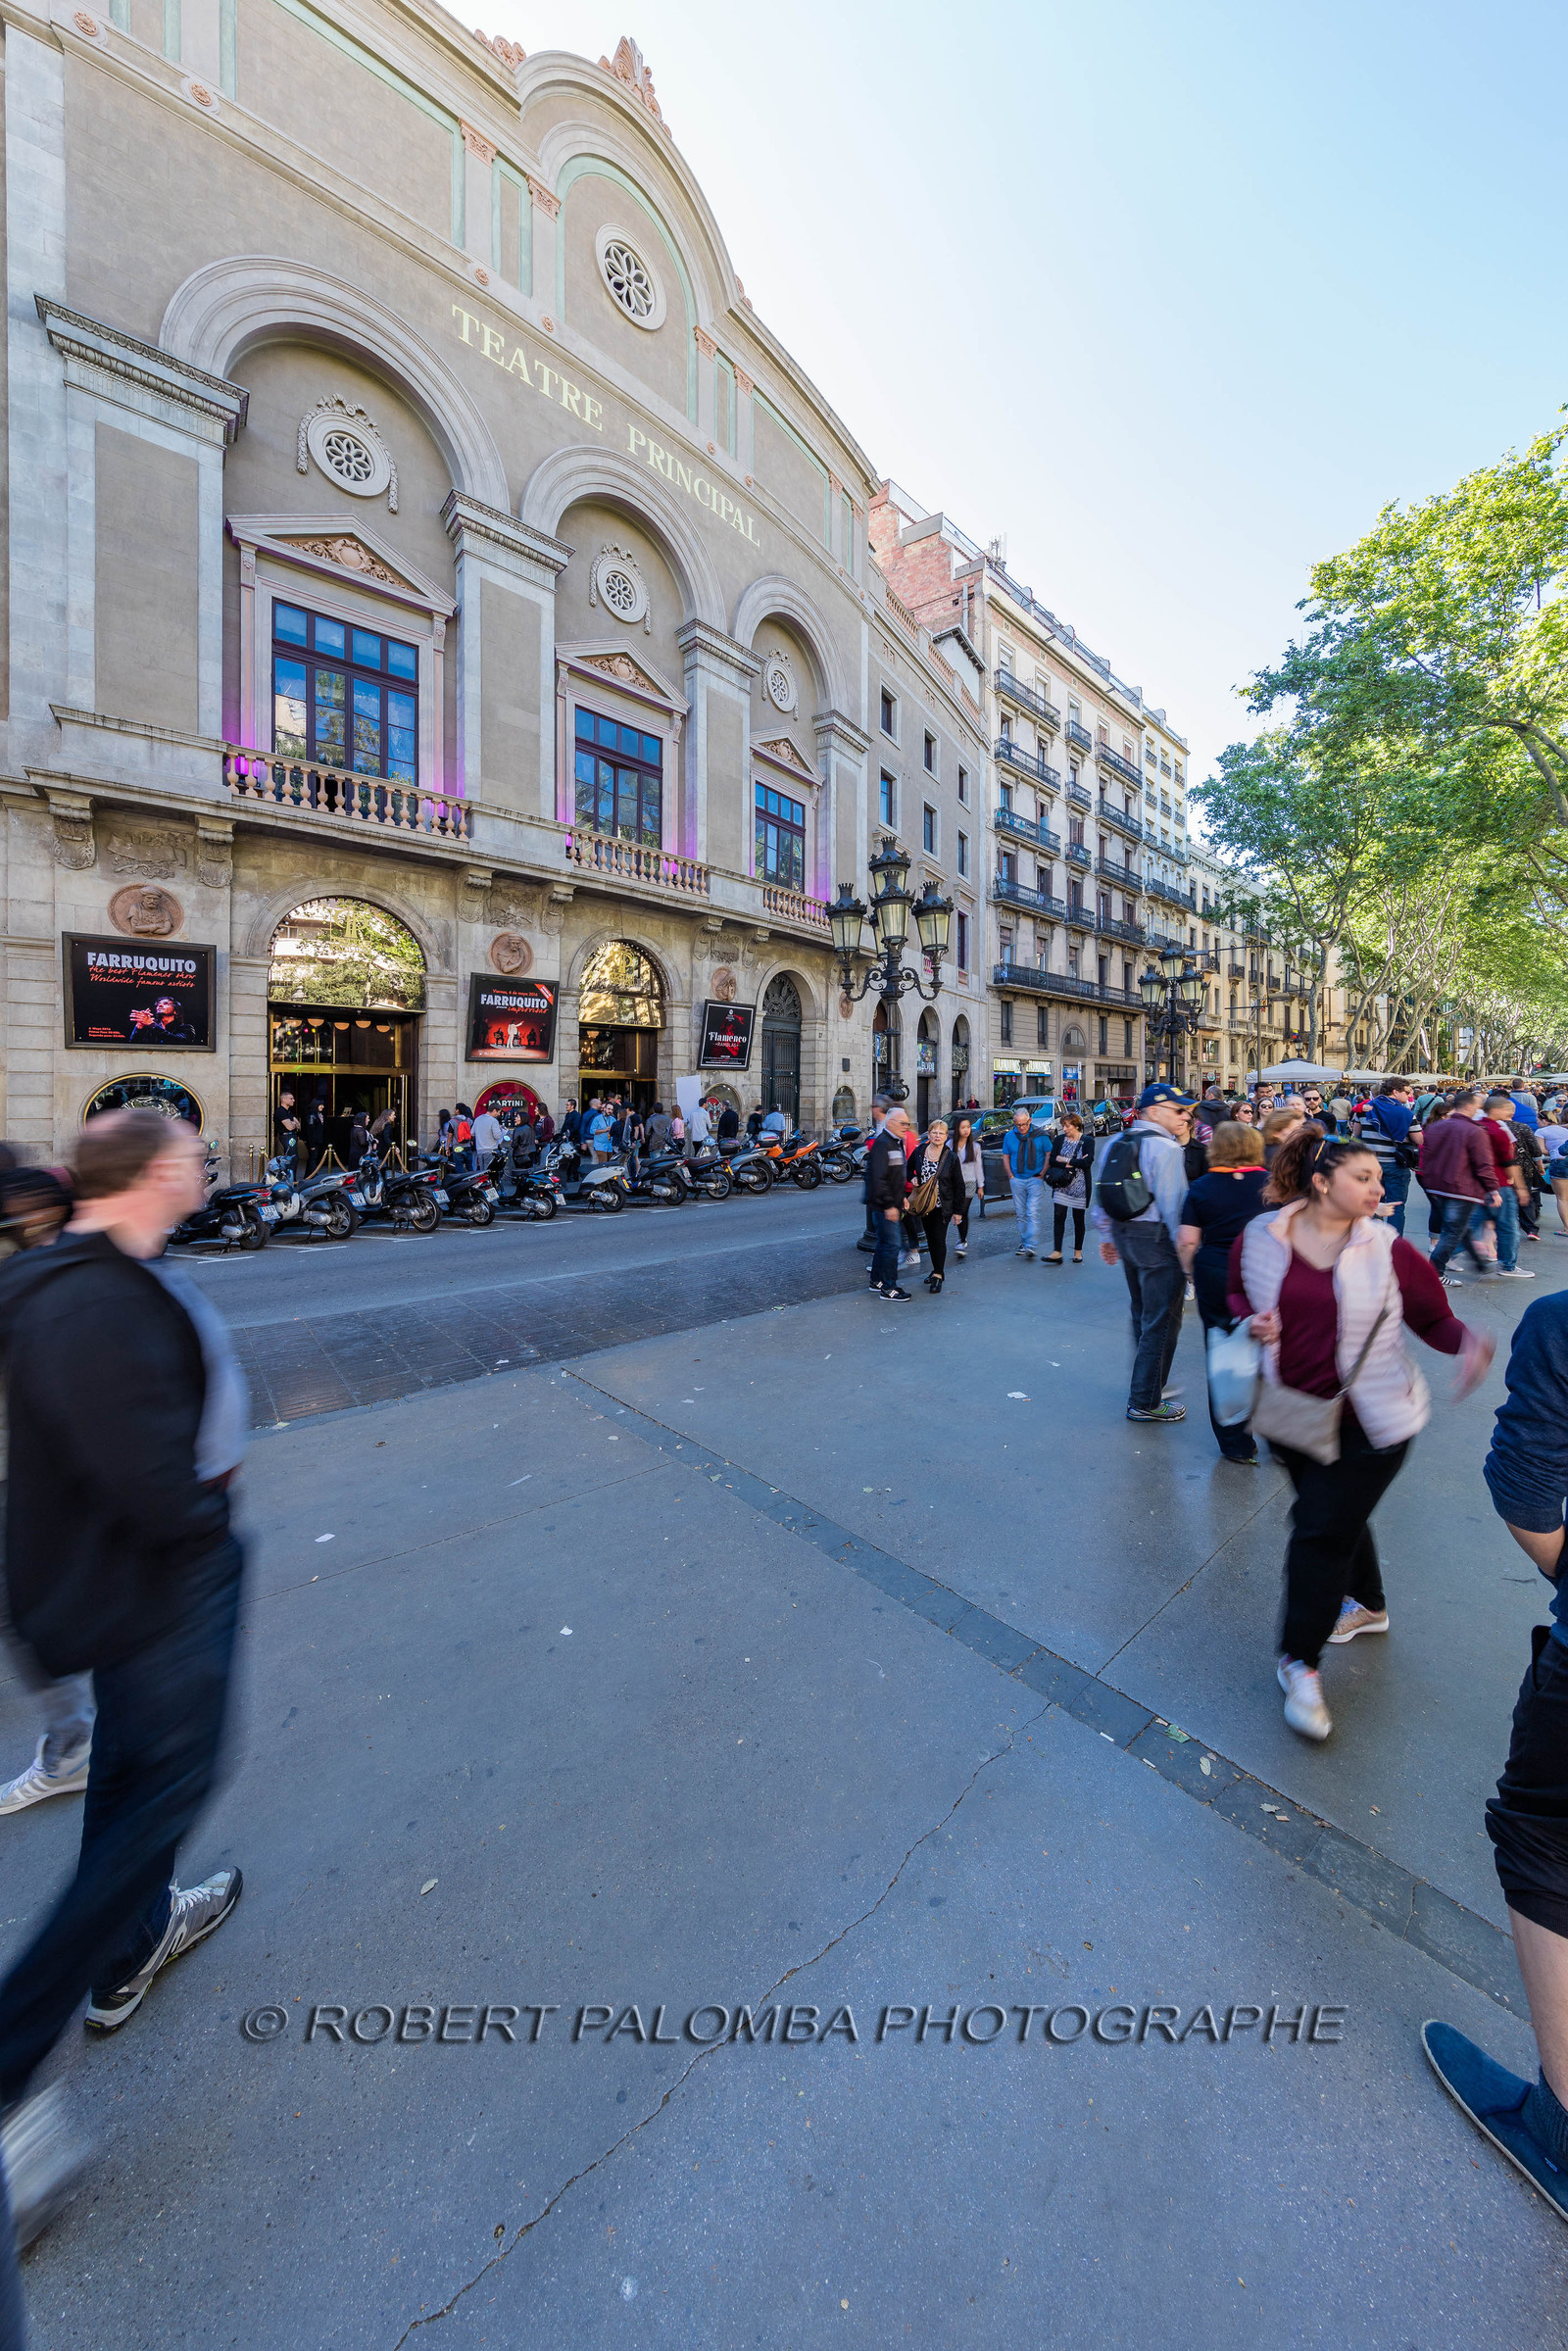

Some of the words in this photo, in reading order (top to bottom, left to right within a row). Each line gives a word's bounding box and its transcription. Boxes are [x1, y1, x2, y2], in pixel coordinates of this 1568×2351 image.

[452, 304, 603, 431] TEATRE
[627, 422, 760, 548] PRINCIPAL
[87, 952, 196, 973] FARRUQUITO
[480, 994, 548, 1009] FARRUQUITO
[708, 1031, 747, 1043] Flamenco
